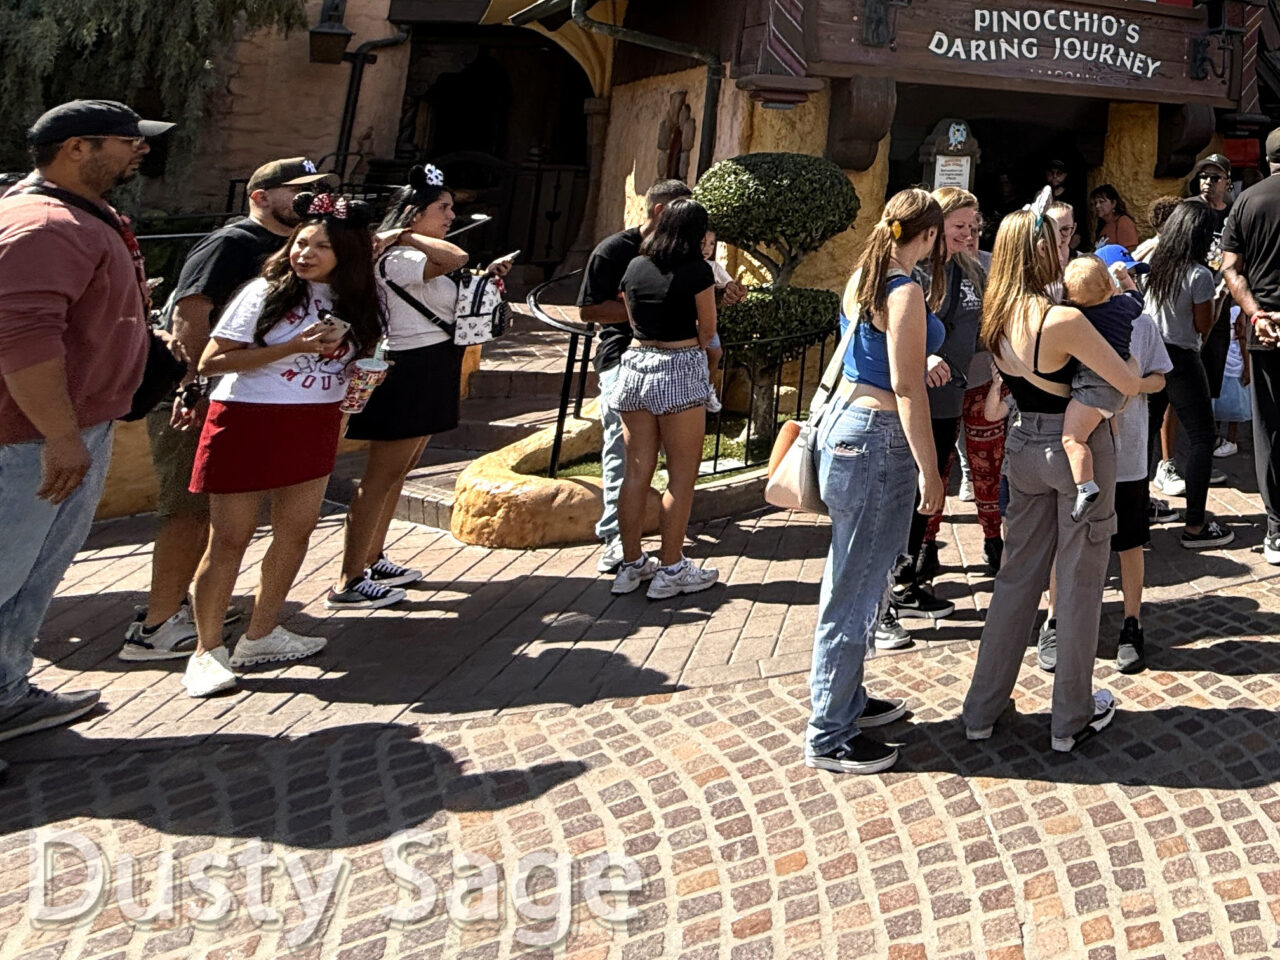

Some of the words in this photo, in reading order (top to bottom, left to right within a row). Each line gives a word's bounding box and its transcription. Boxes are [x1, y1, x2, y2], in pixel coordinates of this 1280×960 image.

[974, 9, 1140, 43] PINOCCHIO'S
[928, 31, 1038, 61] DARING
[1053, 37, 1161, 78] JOURNEY
[281, 368, 346, 391] MOUS
